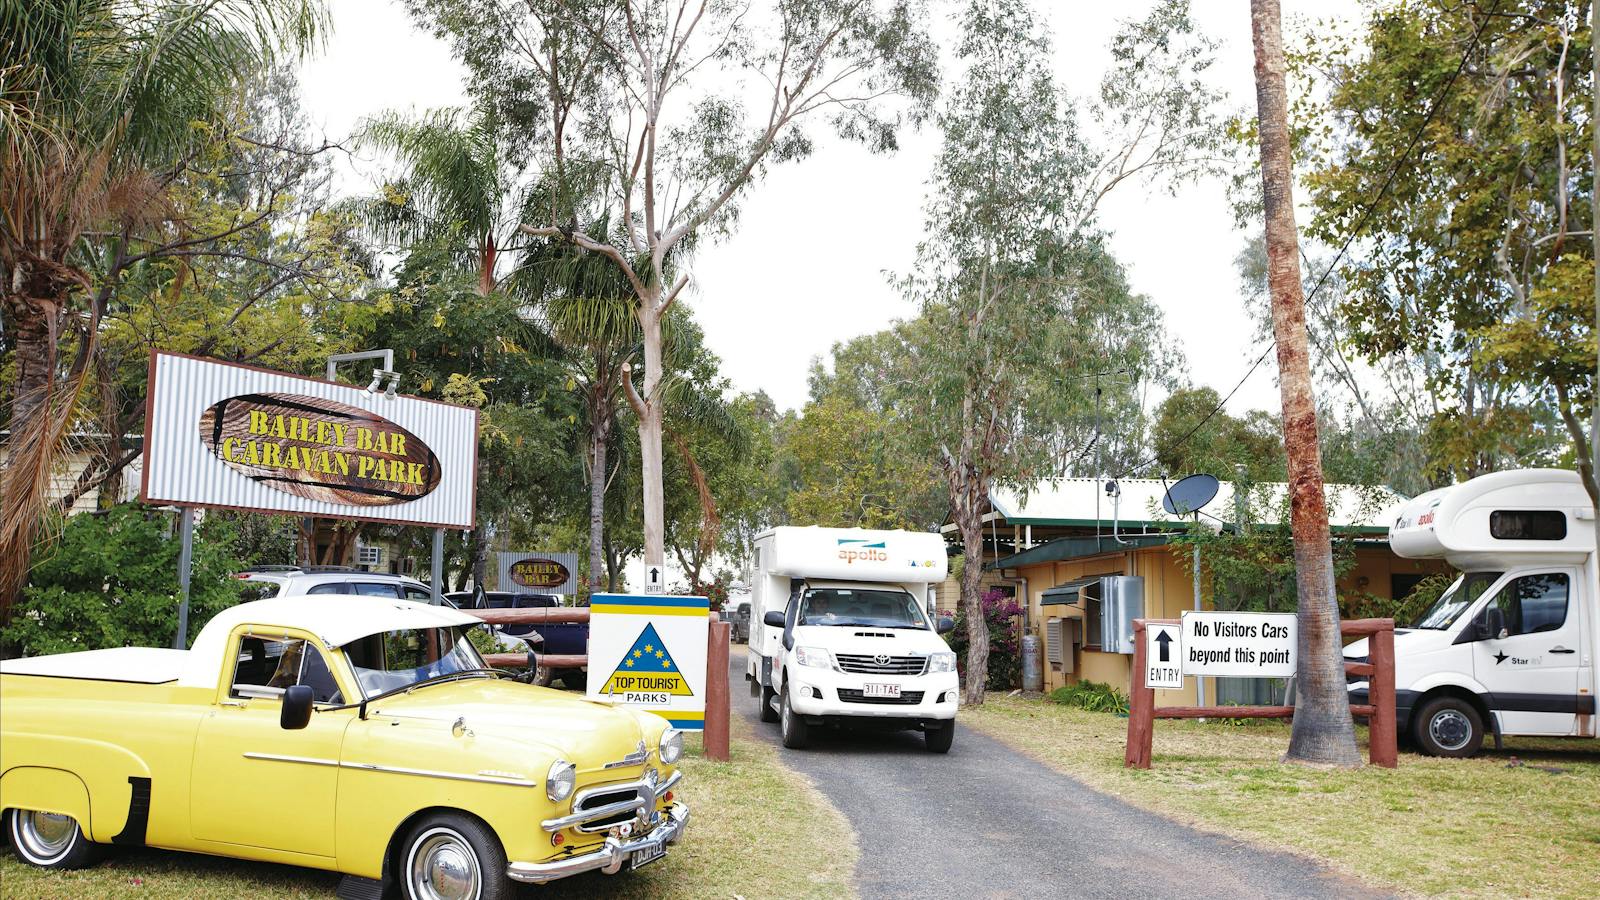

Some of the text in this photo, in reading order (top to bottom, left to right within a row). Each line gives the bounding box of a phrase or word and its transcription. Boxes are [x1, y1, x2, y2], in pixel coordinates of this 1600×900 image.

[249, 409, 408, 456] BAILEY BAR
[222, 436, 425, 486] CARAVAN PARK
[838, 549, 888, 564] apollo
[516, 564, 561, 574] BAILEY
[524, 574, 551, 585] BAR
[647, 585, 662, 593] ENTRY
[1194, 621, 1288, 638] No Visitors Cars
[1189, 647, 1290, 666] beyond this point
[1511, 657, 1529, 665] Star
[1150, 667, 1180, 682] ENTRY
[615, 677, 680, 689] TOP TOURIST
[627, 693, 667, 703] PARKS
